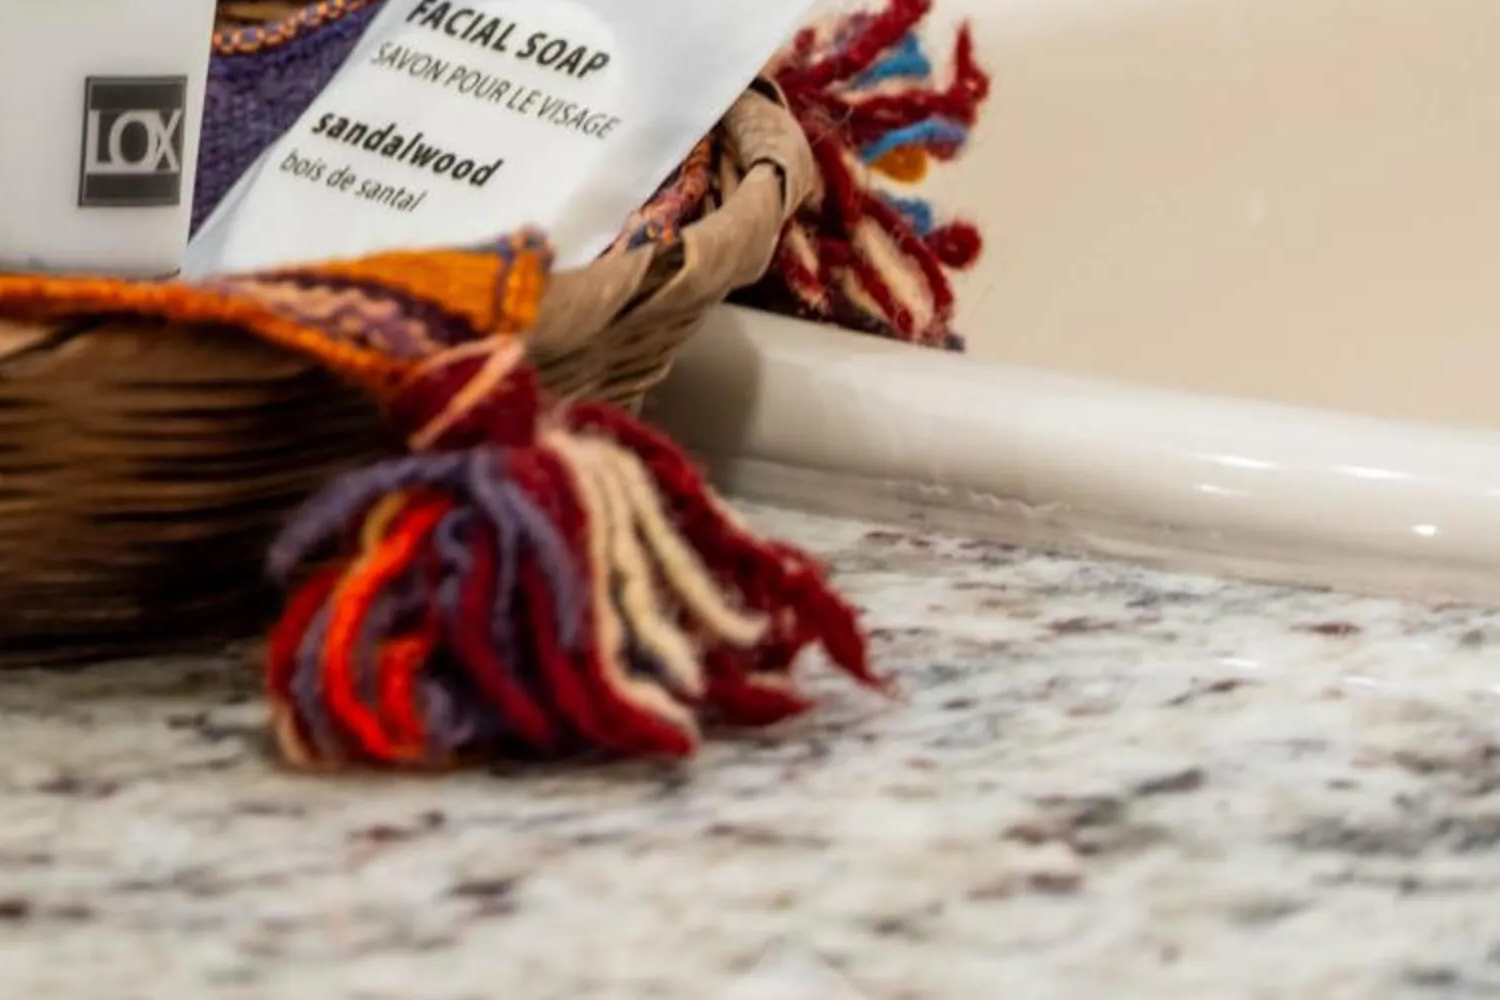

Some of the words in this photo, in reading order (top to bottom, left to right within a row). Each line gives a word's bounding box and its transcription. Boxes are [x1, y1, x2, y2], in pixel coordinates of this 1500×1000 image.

[515, 30, 611, 80] SOAP
[371, 41, 457, 86] SAVON
[446, 64, 507, 103] POUR
[507, 84, 542, 113] LE
[537, 90, 621, 141] VISAGE
[86, 109, 181, 173] LOX
[311, 109, 505, 189] sandalwood
[280, 147, 328, 182] bois
[326, 160, 357, 191] de
[353, 175, 426, 213] santal
